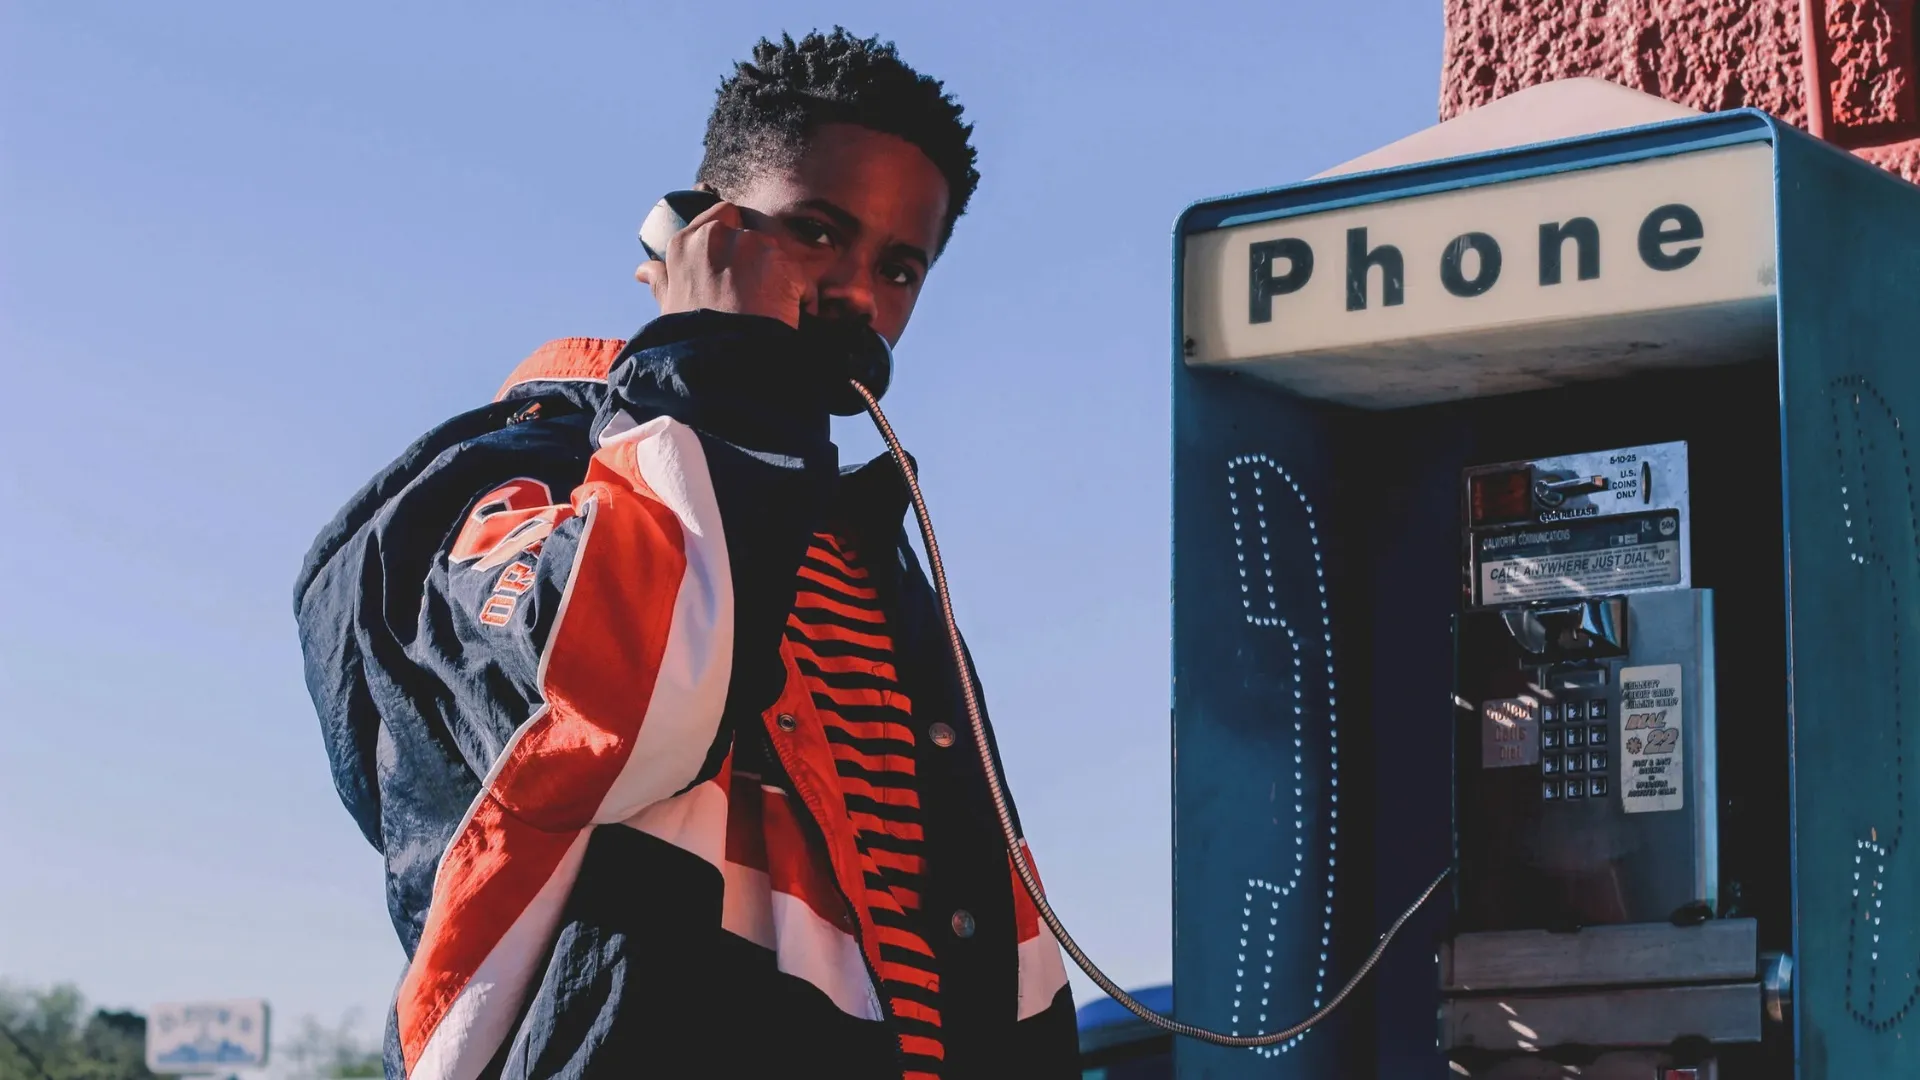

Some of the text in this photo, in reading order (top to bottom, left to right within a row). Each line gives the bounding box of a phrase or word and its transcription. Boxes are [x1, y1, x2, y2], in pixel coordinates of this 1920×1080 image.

[1249, 203, 1704, 324] Phone
[1610, 454, 1637, 465] 5-10-25
[1620, 469, 1637, 478] U.S.
[1612, 480, 1637, 490] COINS
[1616, 490, 1637, 499] ONLY
[1518, 529, 1571, 546] COMMUNICATIONS
[1490, 565, 1518, 581] CALL
[1523, 558, 1589, 576] ANYWHERE
[1592, 554, 1622, 569] JUST
[1624, 552, 1650, 565] DIAL
